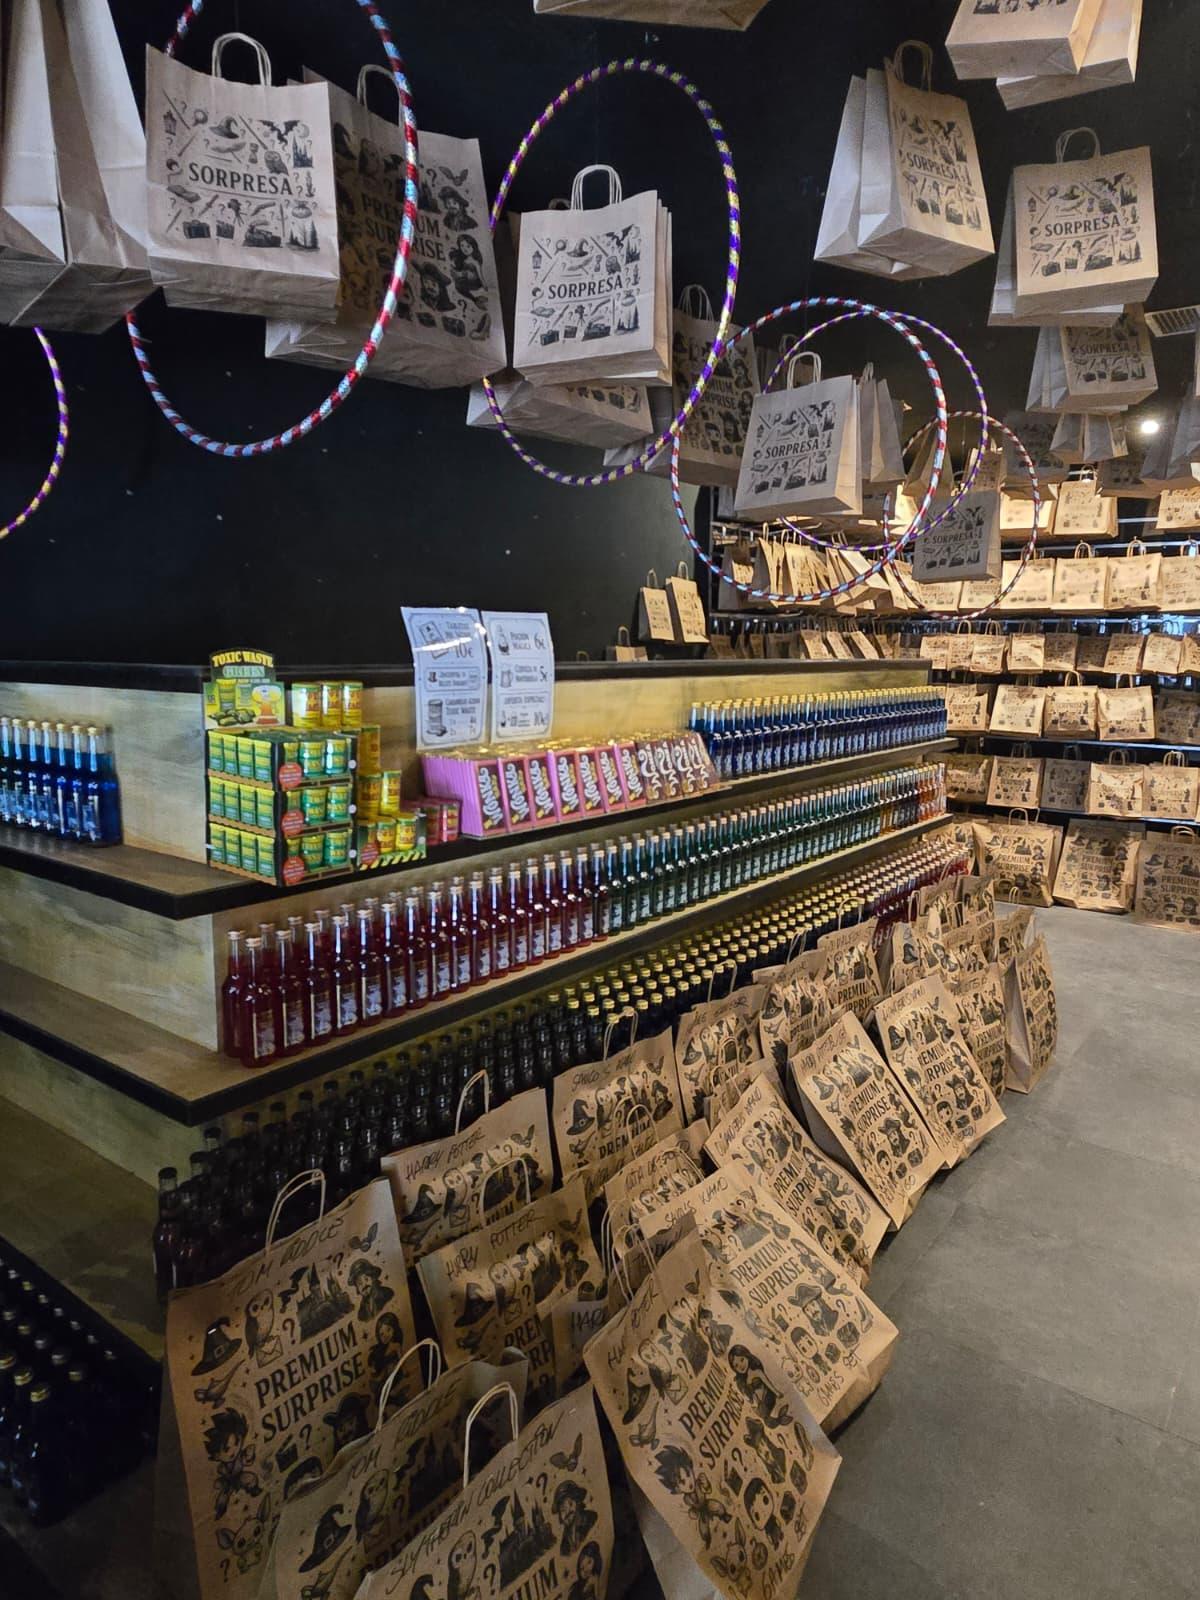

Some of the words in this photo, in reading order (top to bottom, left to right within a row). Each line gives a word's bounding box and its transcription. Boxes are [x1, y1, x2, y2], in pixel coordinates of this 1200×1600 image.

[189, 162, 293, 195] SORPRESA
[907, 152, 961, 182] SORPRESA
[362, 194, 440, 239] PREMUM
[367, 218, 446, 261] SURRISE
[1045, 215, 1121, 237] SORPRESA
[548, 275, 623, 299] SORPRESA
[764, 440, 820, 458] SORPRESA
[932, 532, 973, 544] SORPRESA
[212, 651, 242, 668] TOXIC
[241, 650, 275, 668] WASTE
[479, 767, 503, 826] WONKA
[505, 763, 530, 821] WONKA
[529, 760, 554, 815] WONKA
[557, 756, 580, 811] WONKA
[580, 754, 601, 808] WONKA
[600, 751, 622, 803] WONKA
[621, 748, 643, 799] WONKA
[849, 1079, 881, 1117] PREMIUM
[857, 1096, 891, 1135] SURPRISE
[490, 1209, 545, 1249] POTTER
[729, 1238, 787, 1288] PREMIUM
[748, 1255, 805, 1309] SURPRISE
[255, 1321, 358, 1409] PREMIUM
[262, 1351, 366, 1444] SURPRISE
[678, 1357, 728, 1440] PREMIUM
[699, 1383, 747, 1470] SURPRISE
